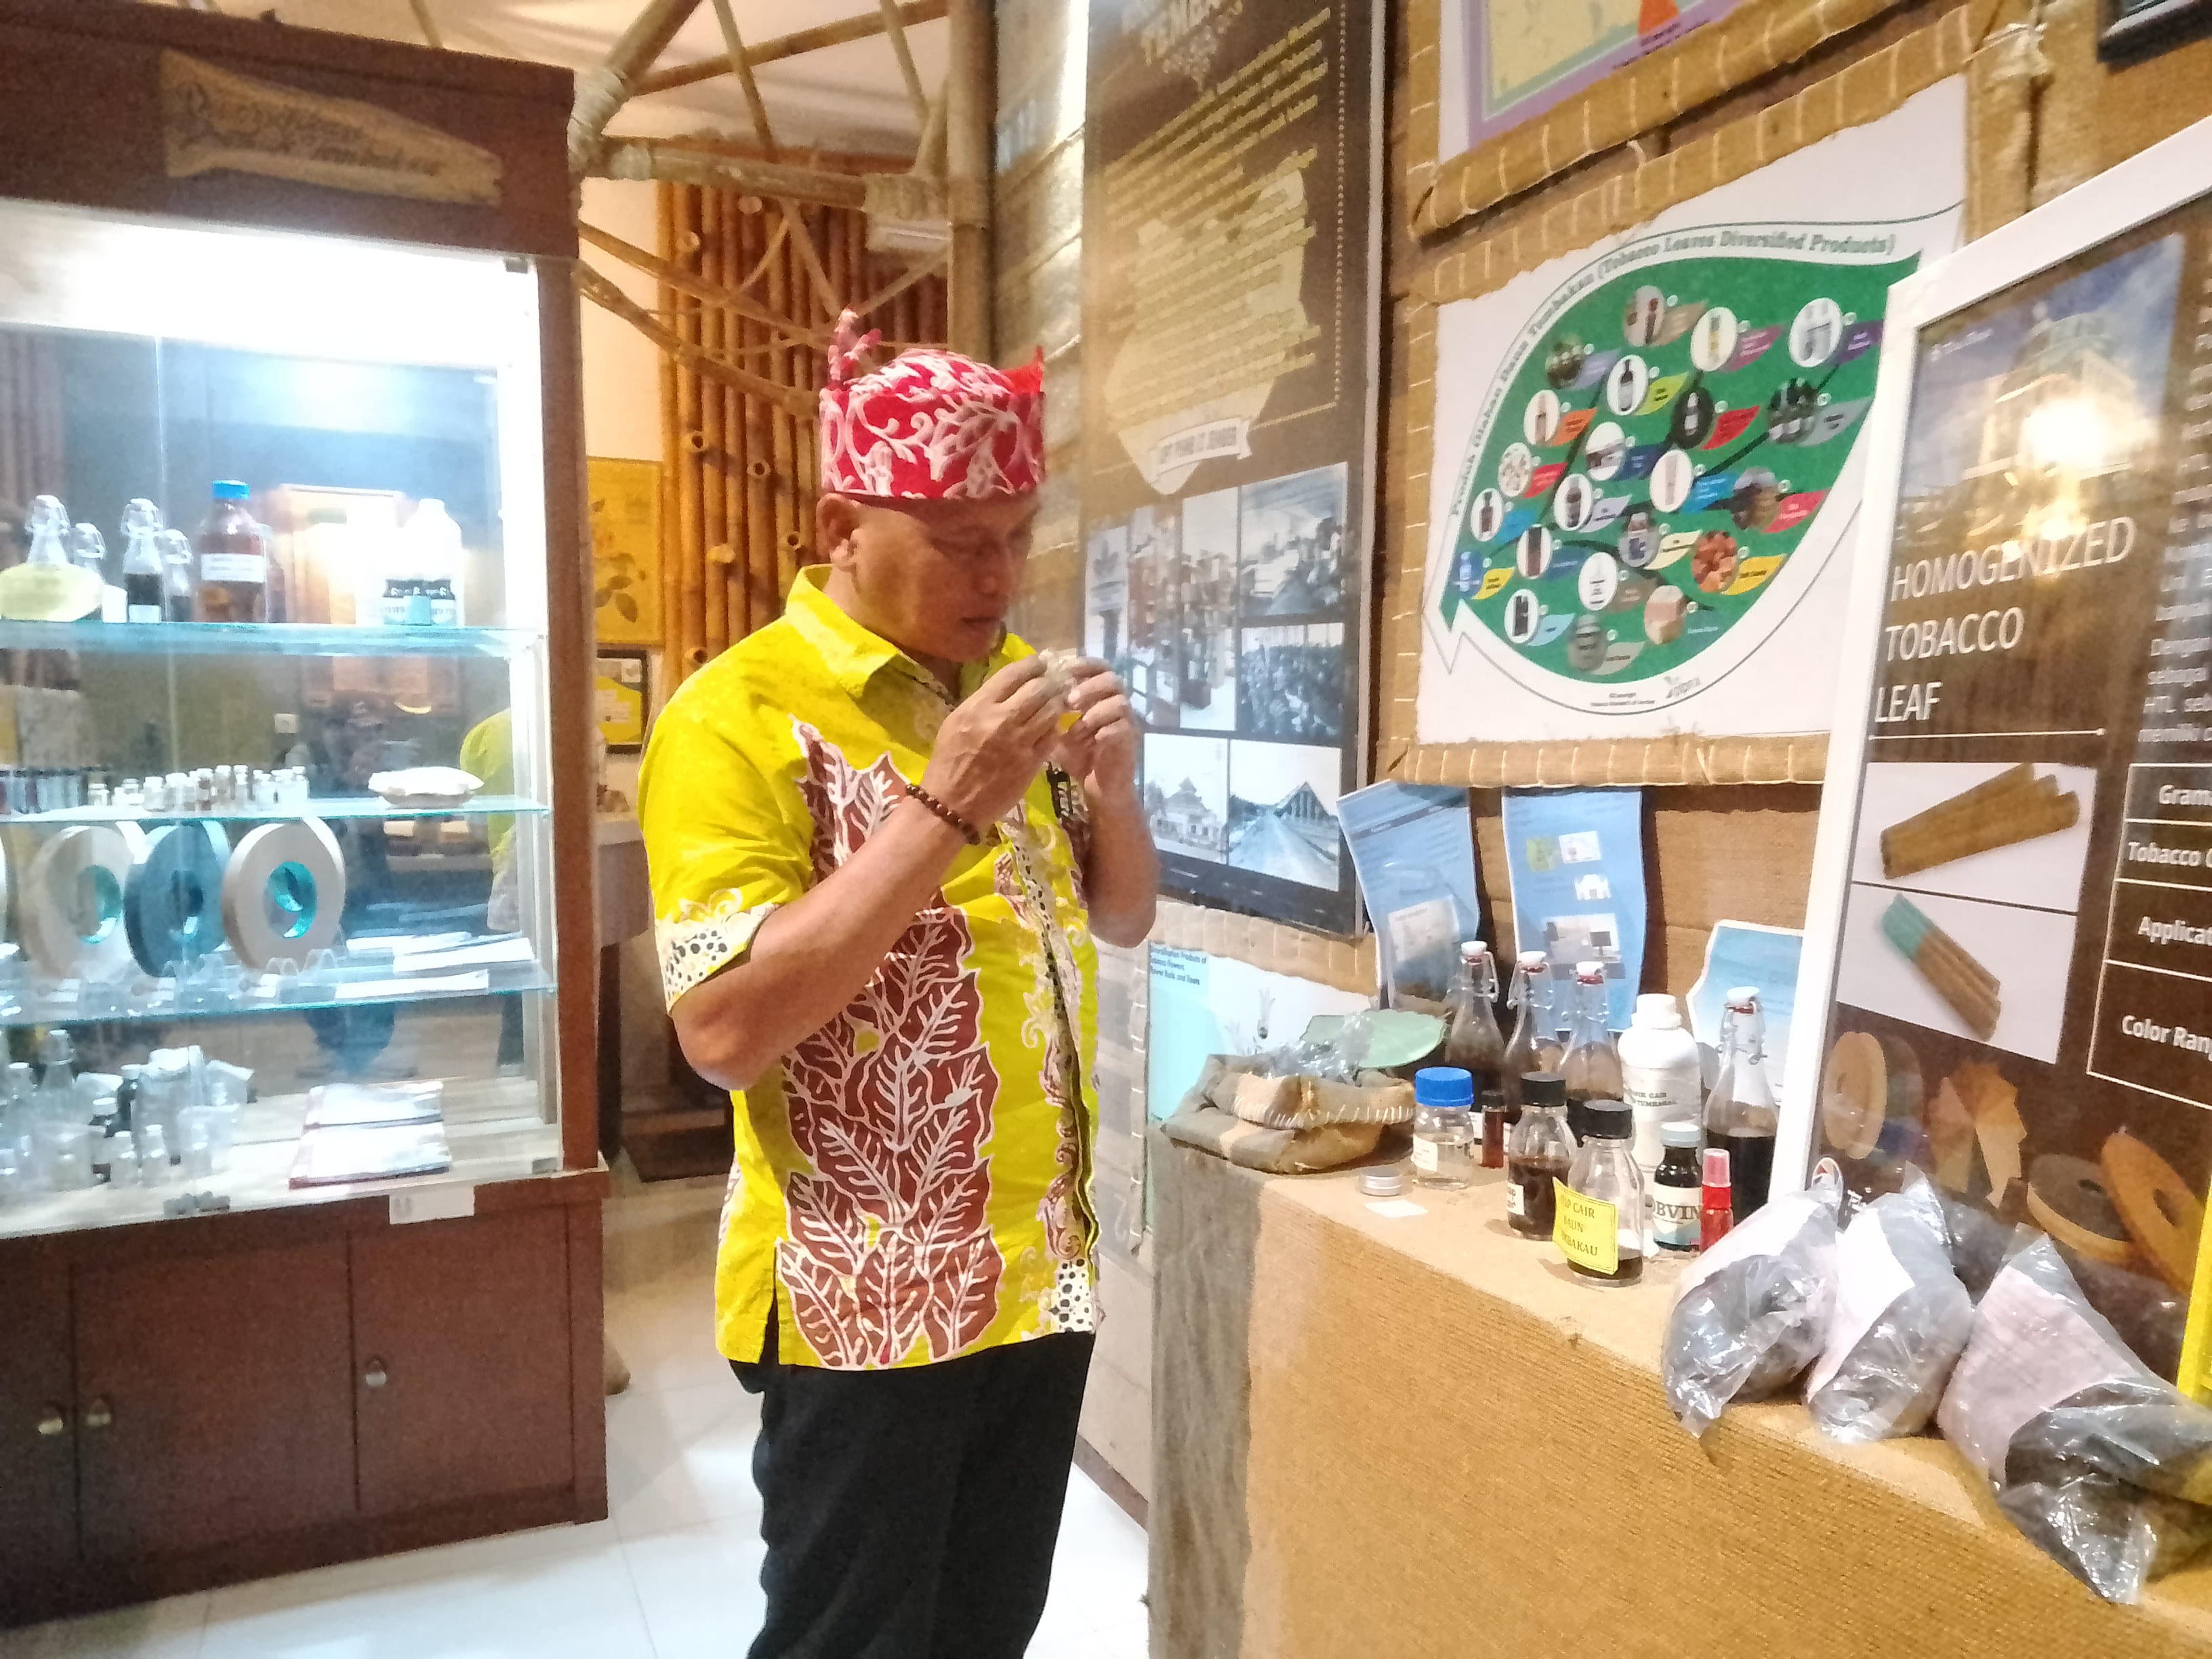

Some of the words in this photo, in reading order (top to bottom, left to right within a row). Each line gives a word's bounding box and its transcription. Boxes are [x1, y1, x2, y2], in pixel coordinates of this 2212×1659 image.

[1889, 516, 2136, 602] HOMOGENIZED
[1885, 607, 2025, 662] TOBACCO
[1875, 681, 1943, 722] LEAF
[2128, 842, 2202, 867] Tobacco
[2122, 1015, 2172, 1043] Color
[1573, 1202, 1595, 1218] CAIR
